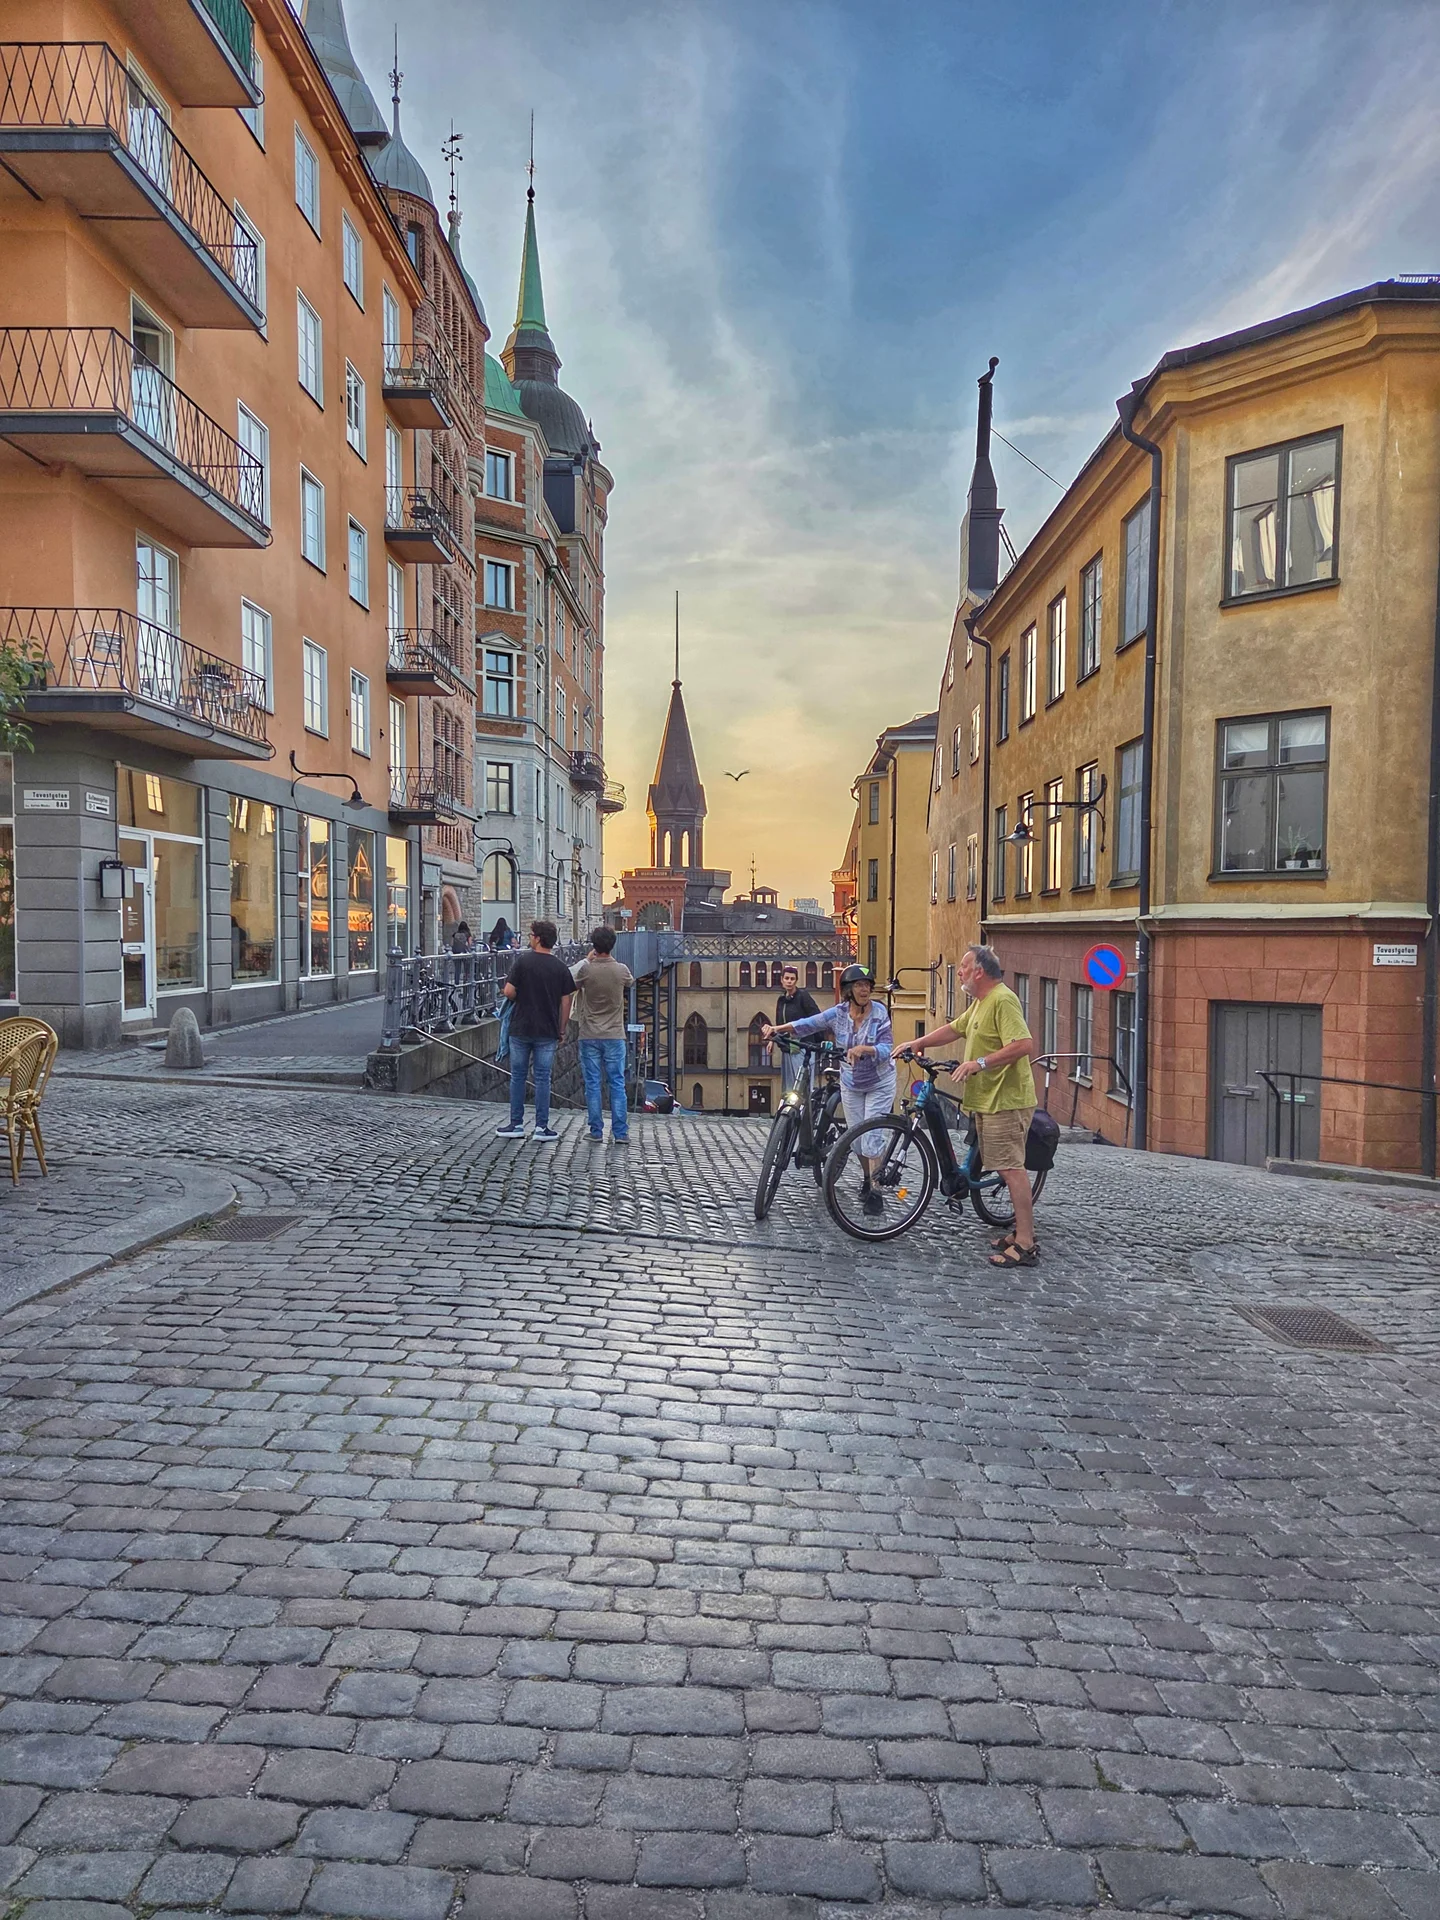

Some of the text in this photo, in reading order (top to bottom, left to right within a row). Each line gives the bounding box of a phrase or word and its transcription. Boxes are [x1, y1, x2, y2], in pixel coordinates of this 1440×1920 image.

[32, 791, 68, 800] Tavastgatan
[1376, 946, 1415, 954] Tavastgatan
[1376, 956, 1381, 964] 6
